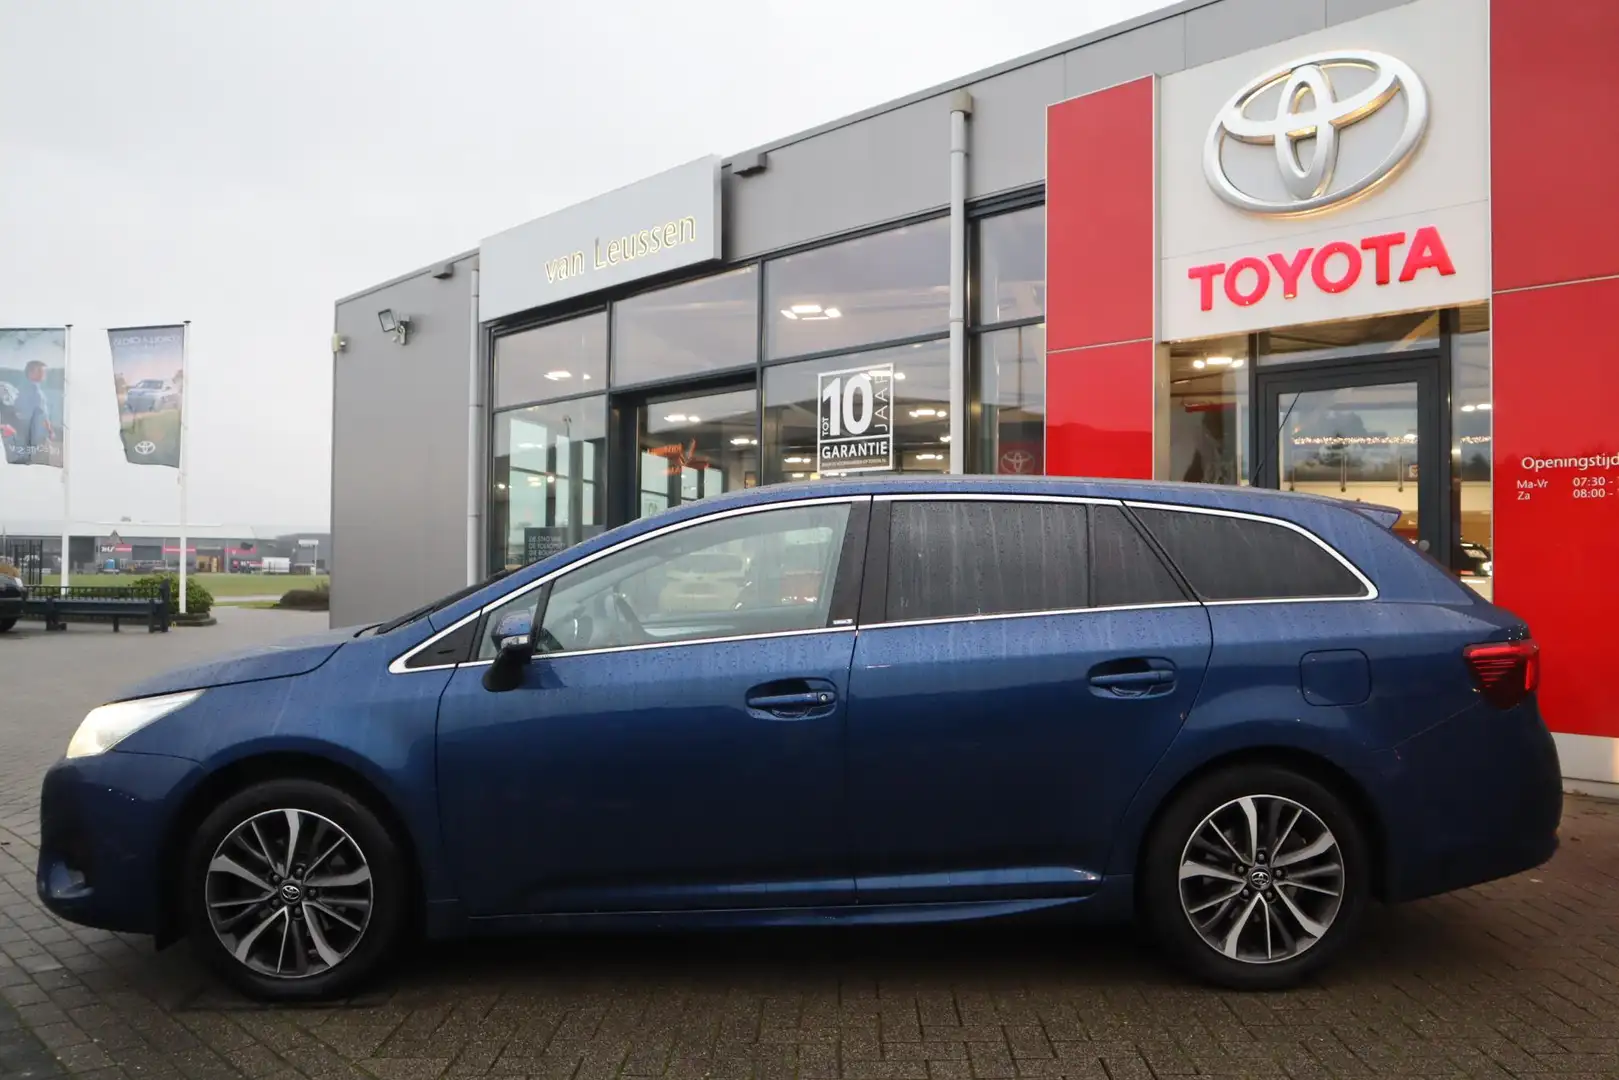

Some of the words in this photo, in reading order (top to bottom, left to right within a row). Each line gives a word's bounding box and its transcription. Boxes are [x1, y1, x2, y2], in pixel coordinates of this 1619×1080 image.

[544, 249, 585, 284] van
[594, 215, 696, 270] Leussen
[1188, 225, 1456, 312] TOYOTA
[822, 373, 874, 435] 10
[821, 417, 830, 437] TOT
[822, 441, 888, 459] GARANTIE
[1521, 452, 1619, 472] Openingstijd
[1516, 478, 1549, 490] Ma-Vr
[1572, 476, 1606, 487] 07:30
[1517, 490, 1531, 501] Za
[1572, 488, 1606, 499] 08:00
